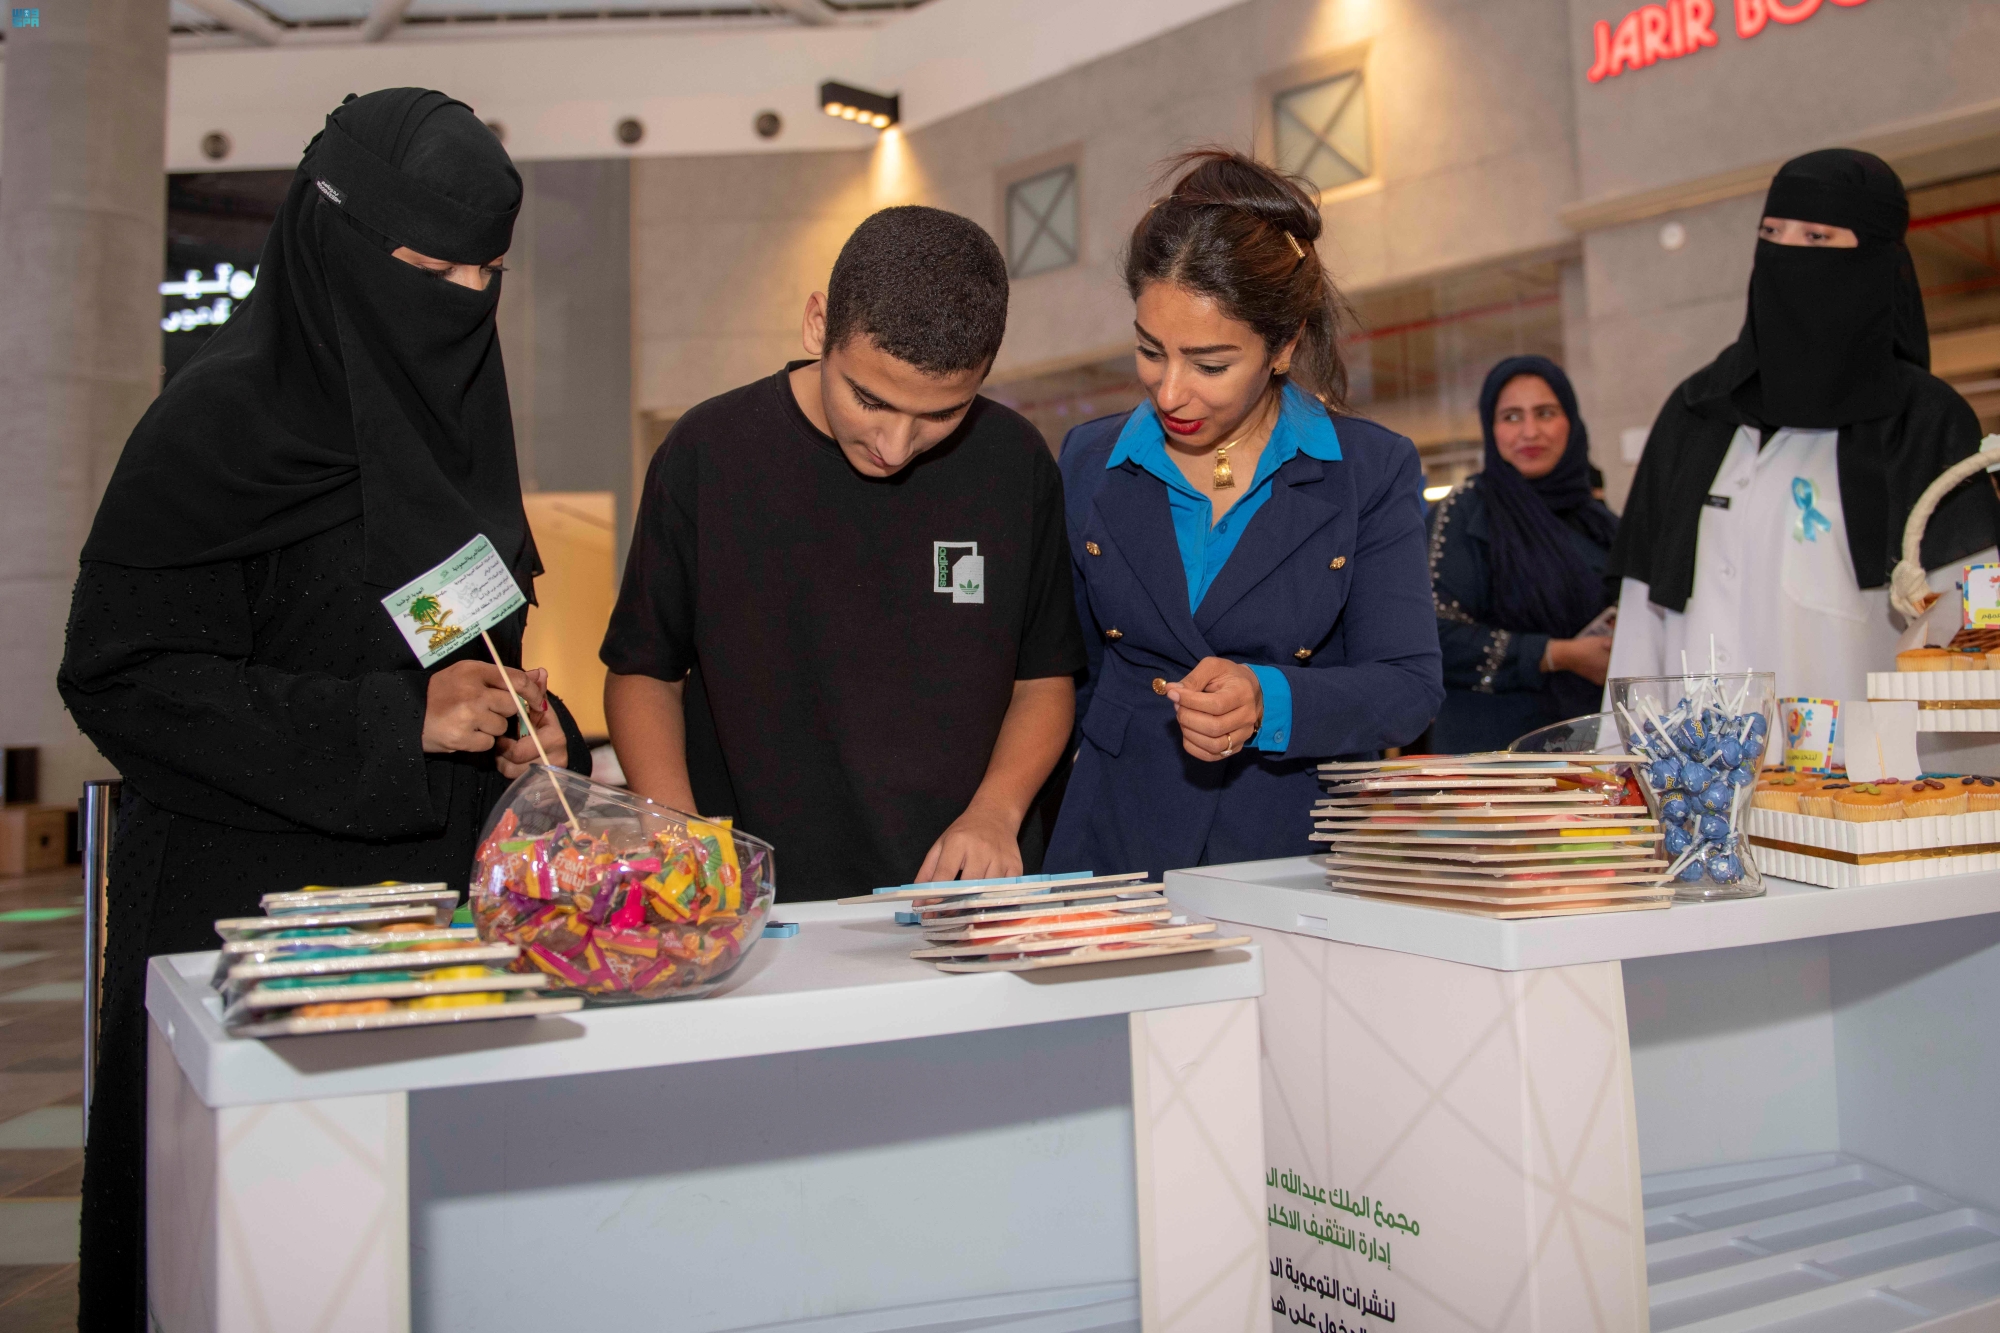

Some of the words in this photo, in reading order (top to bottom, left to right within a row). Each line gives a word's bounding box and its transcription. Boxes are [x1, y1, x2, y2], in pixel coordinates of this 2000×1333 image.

[1587, 0, 1718, 83] JARIR
[939, 547, 948, 587] adidas
[554, 852, 584, 874] Fresh
[1266, 1167, 1278, 1188] ال
[1280, 1168, 1326, 1206] عبدالله
[1329, 1188, 1370, 1218] الملك
[1374, 1200, 1420, 1236] مجمع
[1303, 1213, 1356, 1251] التثقيف
[1270, 1256, 1283, 1278] ال
[1358, 1232, 1391, 1271] إدارة
[1285, 1257, 1340, 1301] التوعوية
[1288, 1303, 1316, 1328] على
